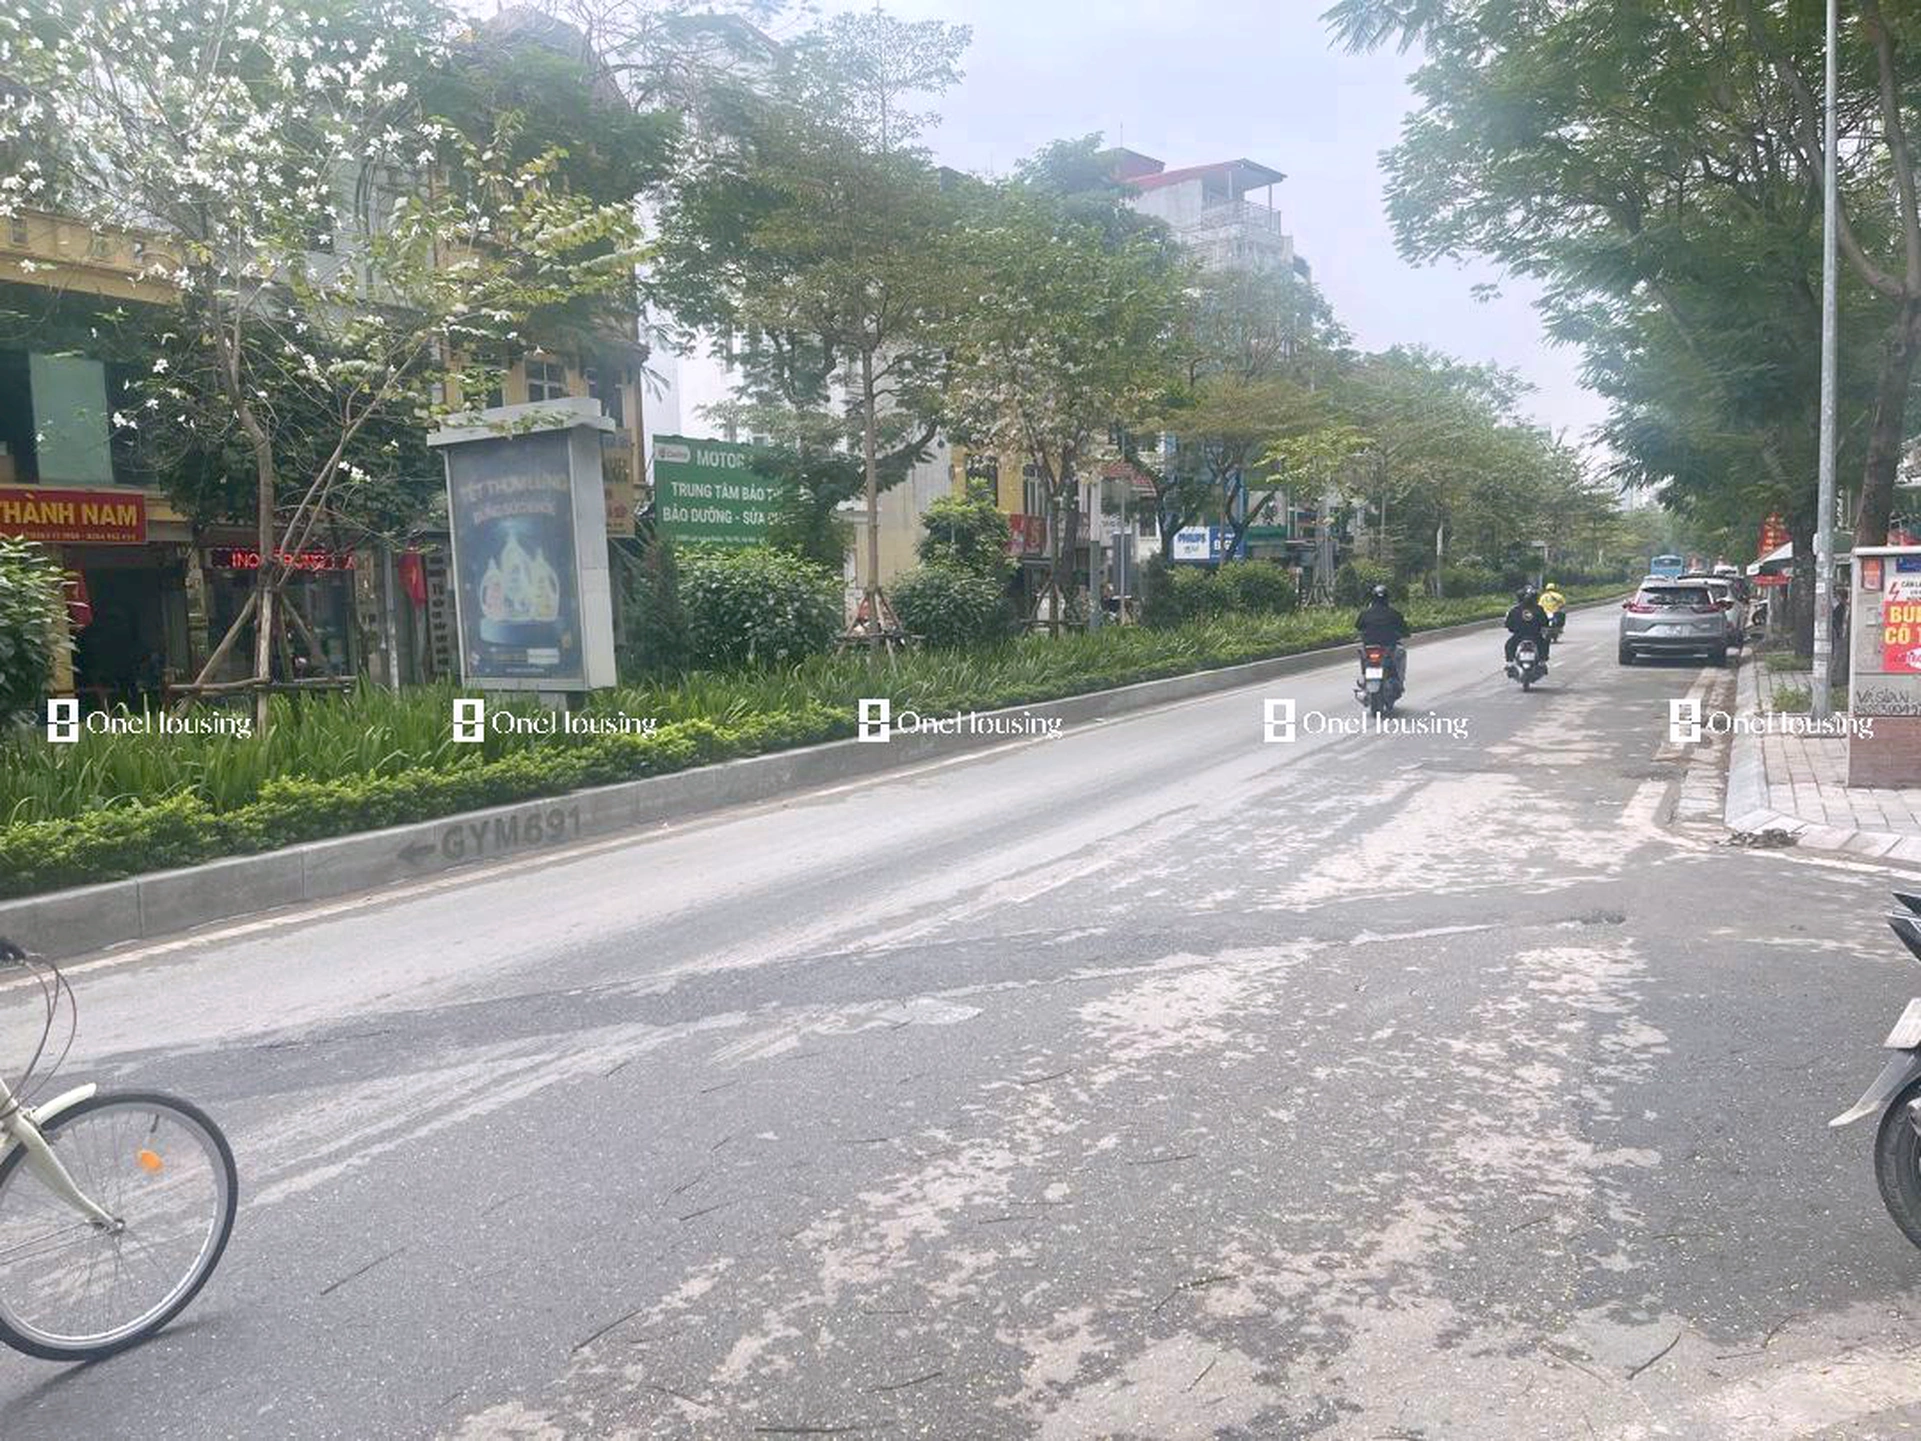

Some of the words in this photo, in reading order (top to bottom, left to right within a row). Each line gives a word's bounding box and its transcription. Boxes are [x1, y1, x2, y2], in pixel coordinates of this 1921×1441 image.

[671, 482, 713, 500] TRUNG
[715, 481, 739, 500] TÂM
[0, 492, 75, 525] HÀNH
[81, 503, 137, 526] NAM
[662, 503, 689, 522] BẢO
[691, 505, 732, 523] DƯỠNG
[231, 553, 262, 570] INO
